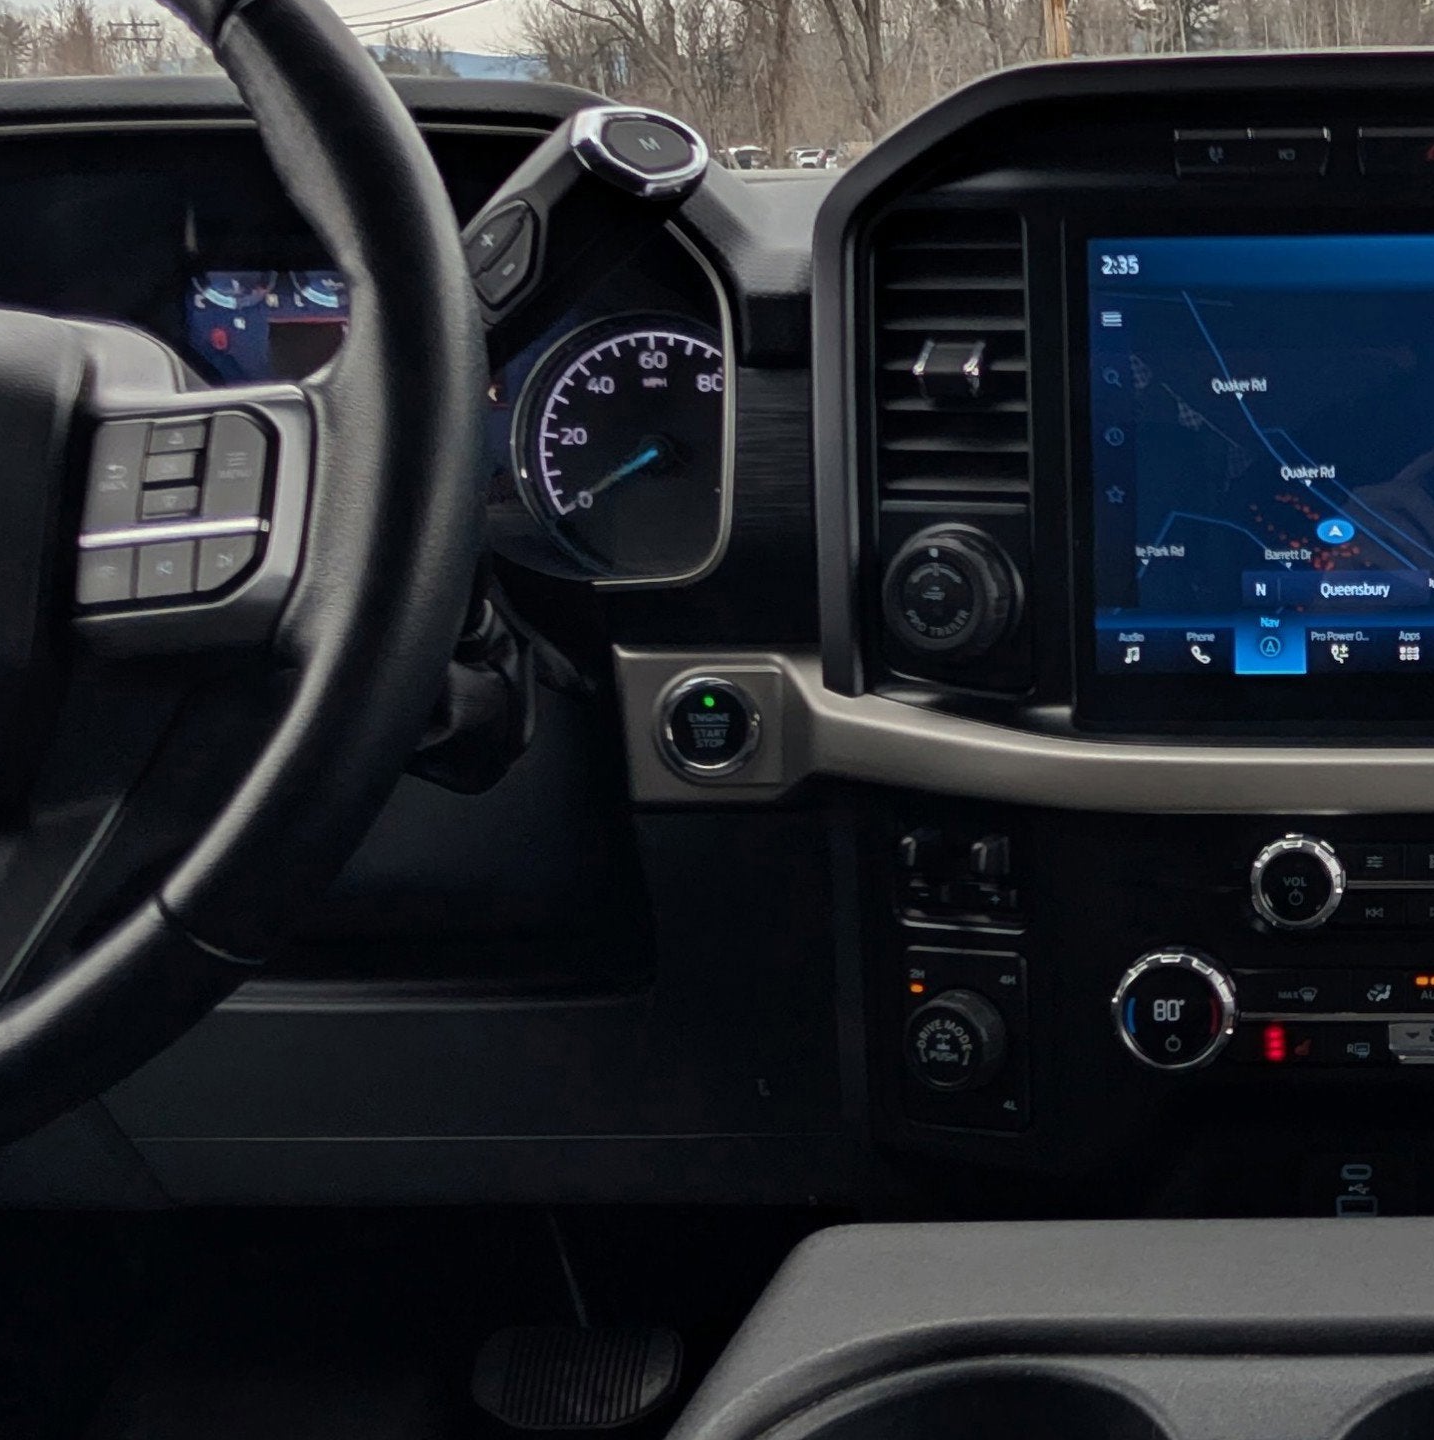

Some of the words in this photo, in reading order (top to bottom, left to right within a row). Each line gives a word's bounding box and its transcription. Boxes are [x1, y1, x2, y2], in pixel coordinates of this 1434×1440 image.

[1101, 254, 1140, 275] 2:35
[638, 350, 668, 370] 60
[587, 376, 616, 394] 40
[642, 376, 668, 388] MPH
[696, 373, 724, 392] 80
[1211, 377, 1249, 394] Quaker
[1251, 377, 1268, 392] Rd
[559, 427, 588, 446] 20
[1280, 465, 1318, 481] Quaker
[1320, 465, 1336, 479] Rd
[577, 490, 594, 509] 0
[1145, 545, 1169, 558] Park
[1171, 545, 1185, 558] Rd
[1265, 548, 1298, 561] Barrett
[1300, 548, 1312, 560] Dr
[1255, 583, 1267, 597] N
[1320, 582, 1390, 601] Queensbury
[929, 608, 970, 637] TRAILER
[1260, 617, 1280, 629] Nav
[1118, 631, 1145, 643] Audio
[1186, 631, 1215, 643] Phone
[1311, 630, 1326, 642] Pro
[1327, 630, 1354, 642] Power
[1398, 630, 1421, 644] Apps
[693, 728, 729, 739] START
[1283, 876, 1307, 888] VOL
[1278, 990, 1299, 1000] MAX
[1152, 998, 1186, 1022] 80°
